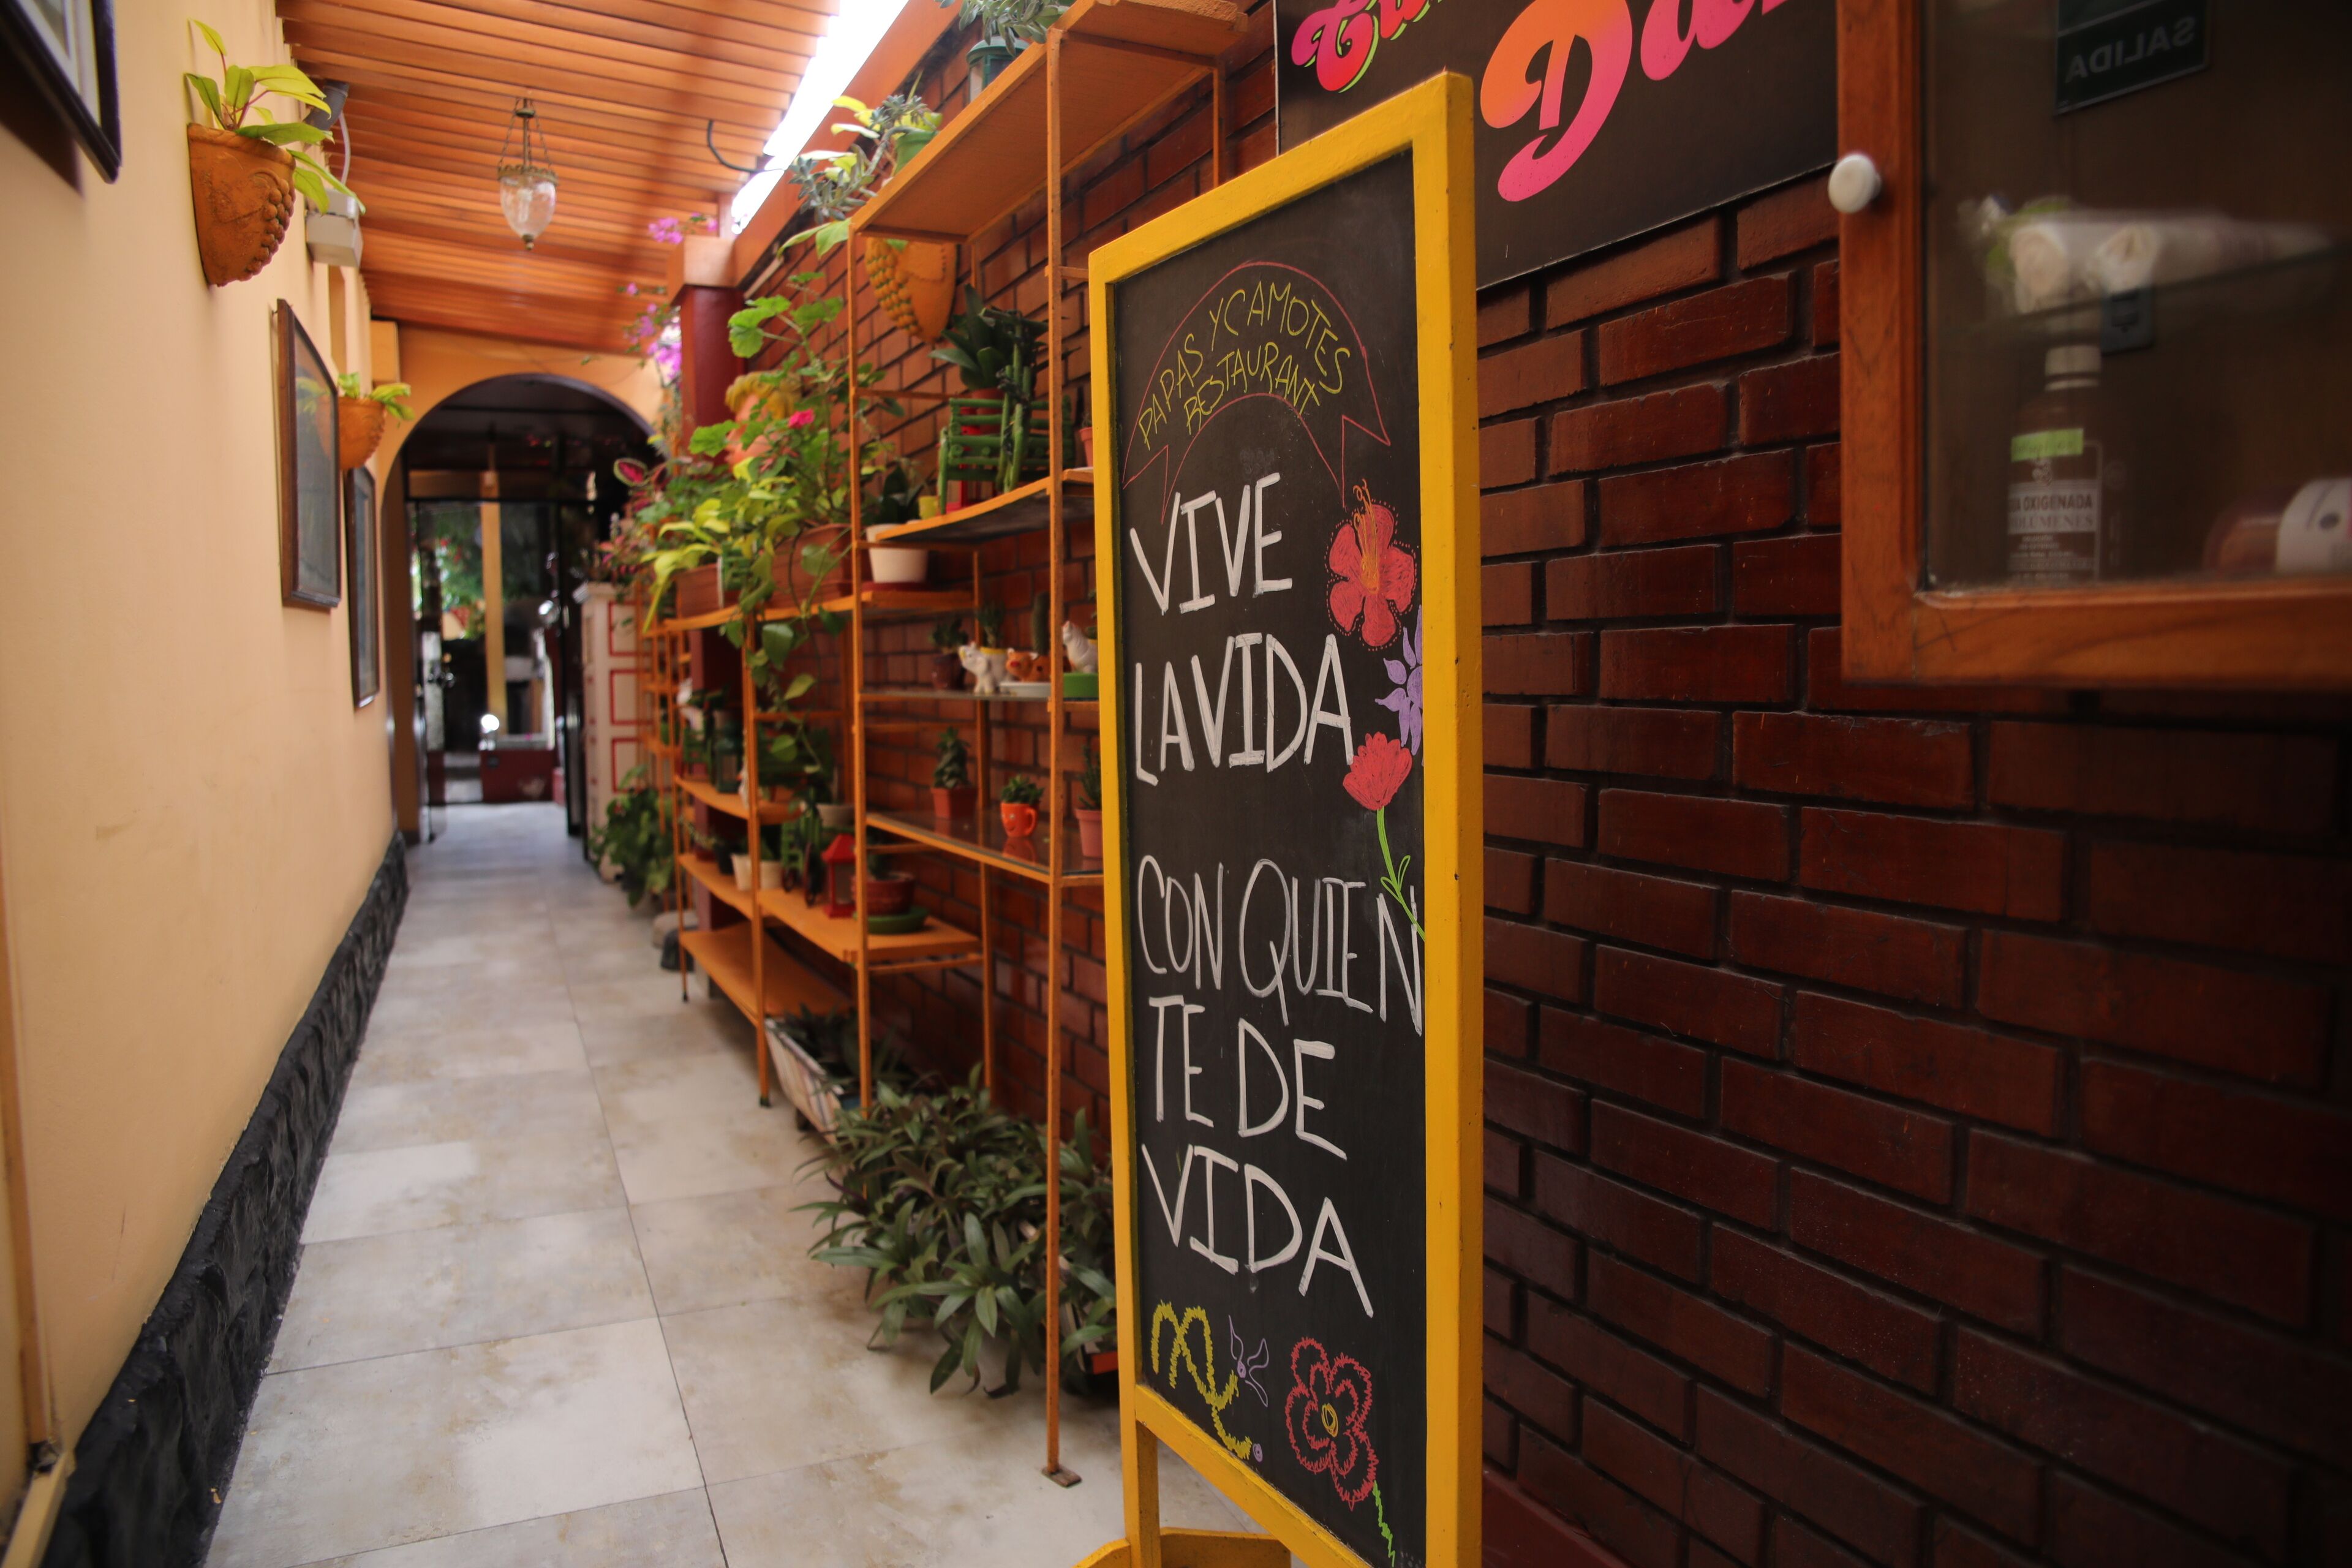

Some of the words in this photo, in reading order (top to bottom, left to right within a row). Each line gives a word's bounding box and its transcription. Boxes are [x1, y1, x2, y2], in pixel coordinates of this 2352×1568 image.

[1139, 333, 1204, 451] PAPAS
[1183, 341, 1321, 435] RESTAURANT
[1129, 472, 1293, 616] VIVE
[2023, 494, 2092, 512] OXIGENADA
[1136, 660, 1196, 786] LA
[1191, 632, 1354, 774] VIDA
[1137, 854, 1224, 990] CON
[1238, 858, 1422, 1037] QUIEN
[1148, 994, 1214, 1128] TE
[1237, 1017, 1348, 1161] DE
[1142, 1143, 1374, 1318] VIDA
